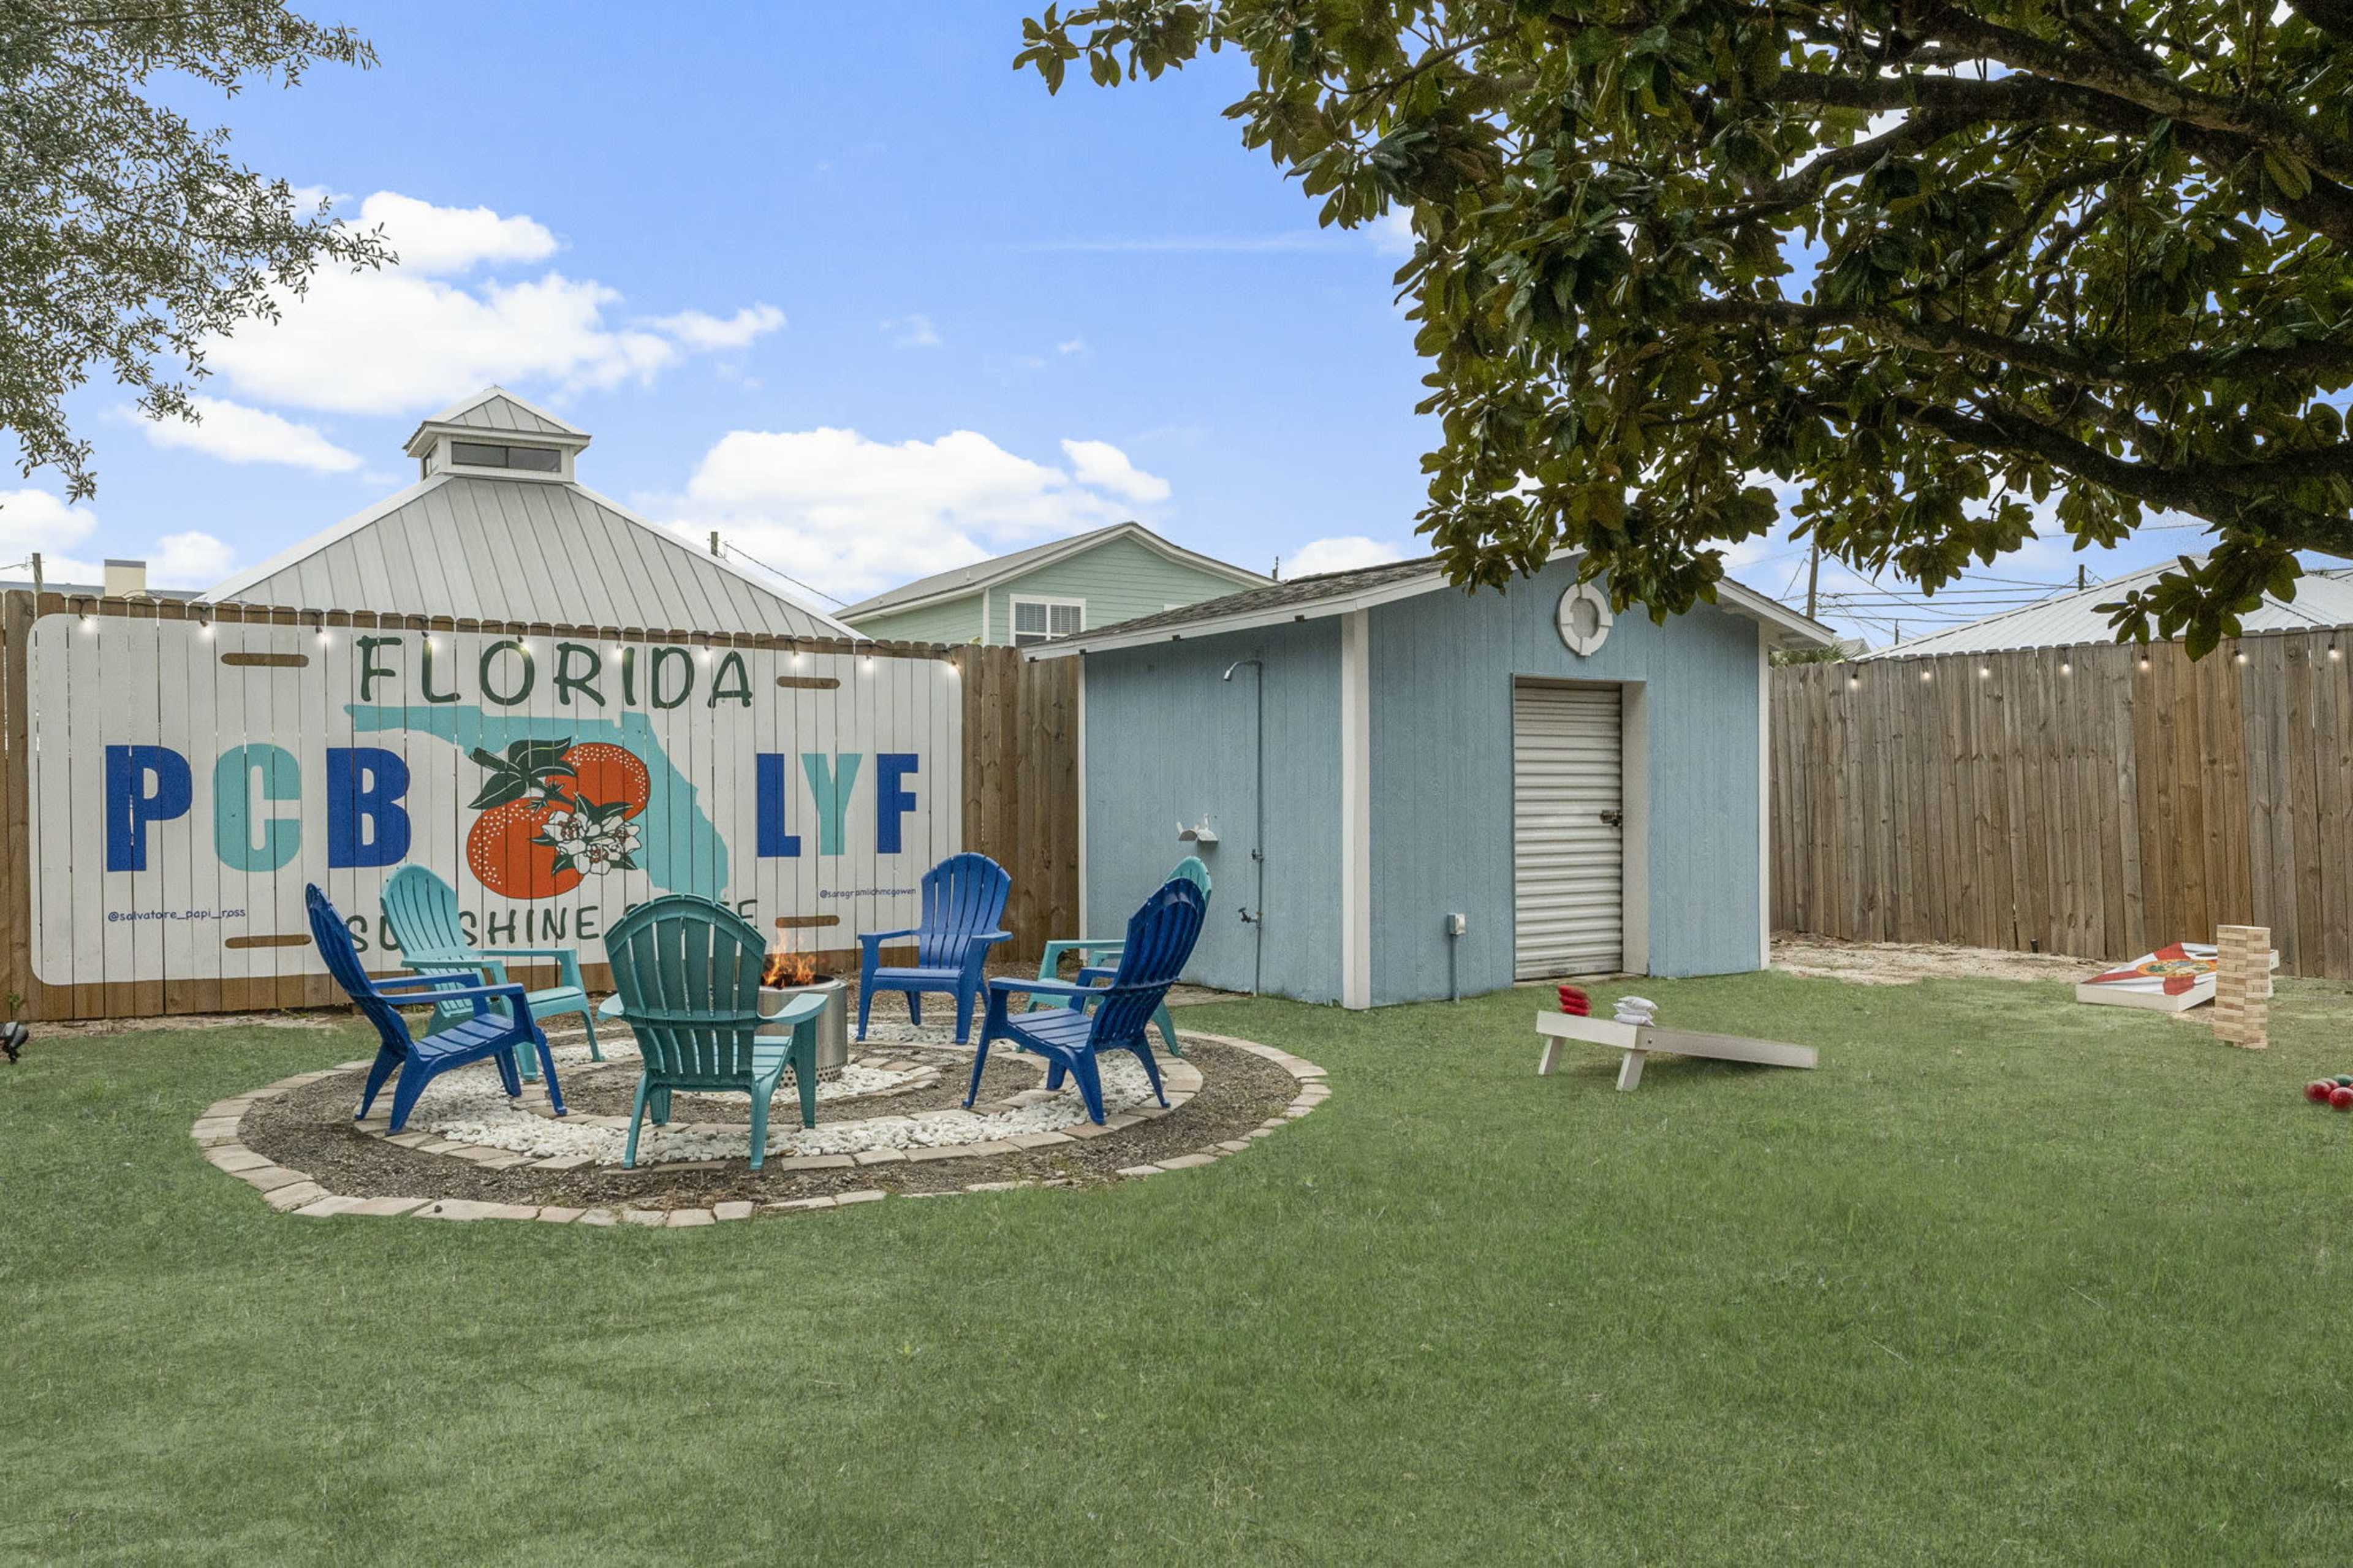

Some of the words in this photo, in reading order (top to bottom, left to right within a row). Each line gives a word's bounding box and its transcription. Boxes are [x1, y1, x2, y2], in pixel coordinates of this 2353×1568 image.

[356, 635, 753, 709] FLORIDA
[105, 743, 412, 873] PCB
[756, 752, 919, 858] LYF
[107, 907, 246, 922] @salvatore_papi_ross
[345, 905, 600, 953] SUSHINE
